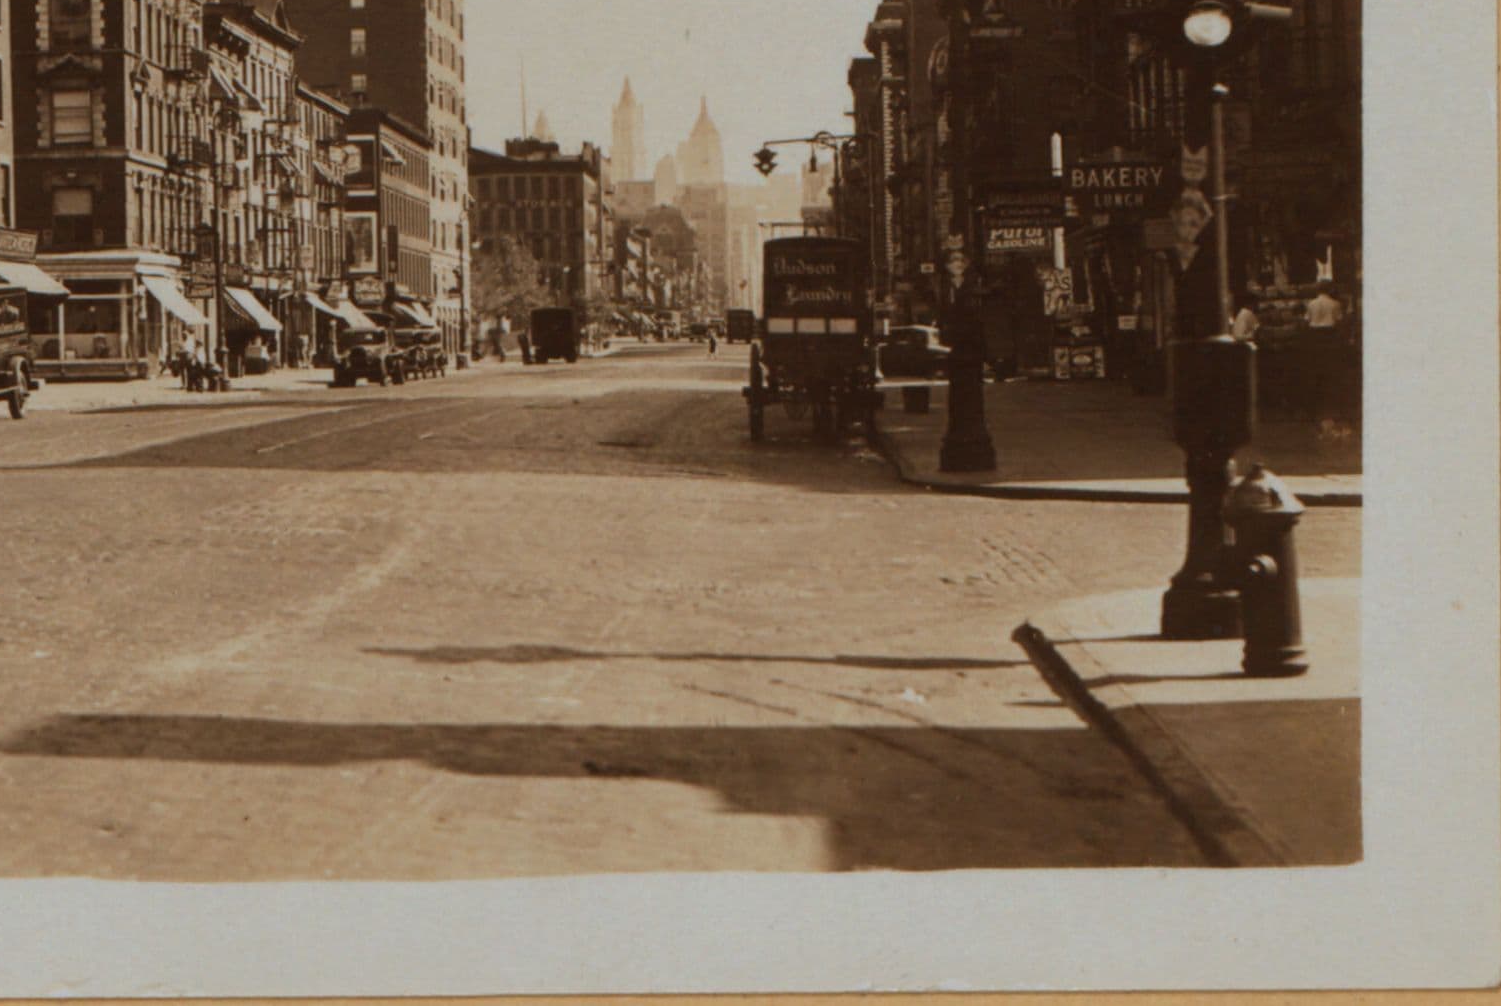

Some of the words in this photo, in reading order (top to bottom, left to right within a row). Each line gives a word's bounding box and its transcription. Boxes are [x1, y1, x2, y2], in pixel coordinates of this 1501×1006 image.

[1071, 166, 1163, 188] BAKERY
[1093, 193, 1144, 207] LUNCH
[987, 238, 1045, 250] GASOLINE
